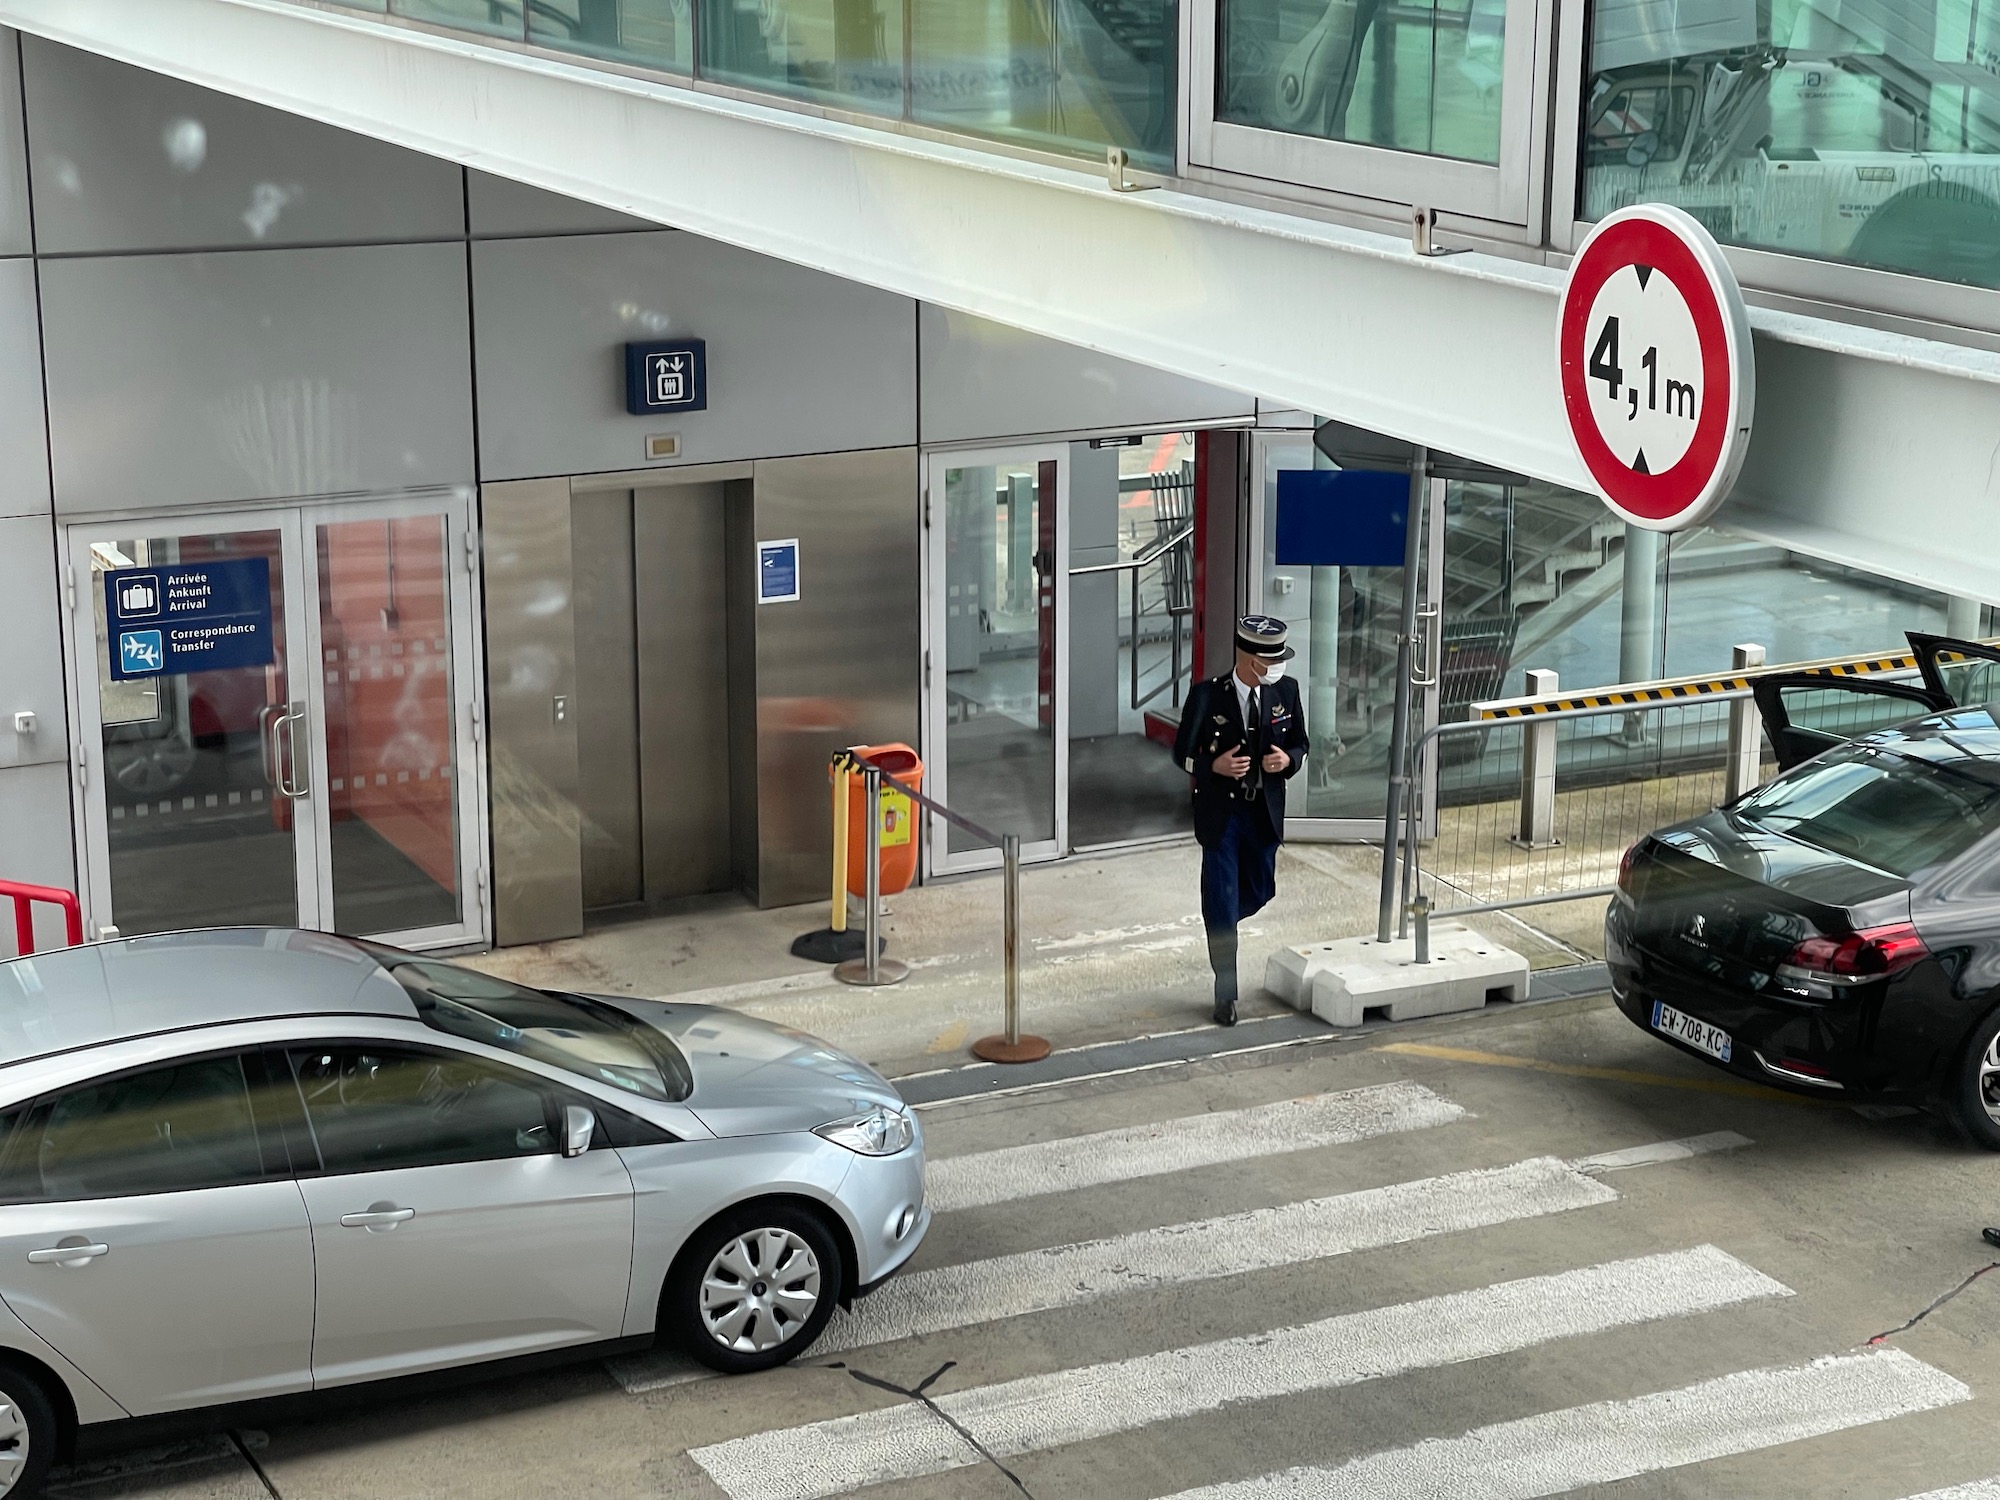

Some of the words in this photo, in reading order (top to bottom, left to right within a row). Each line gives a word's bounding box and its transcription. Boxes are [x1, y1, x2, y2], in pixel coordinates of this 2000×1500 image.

[167, 573, 208, 587] Arrivée
[168, 585, 212, 599] Ankunft
[169, 598, 207, 612] Arrival
[170, 623, 256, 640] Correspondance
[171, 640, 216, 653] Transfer
